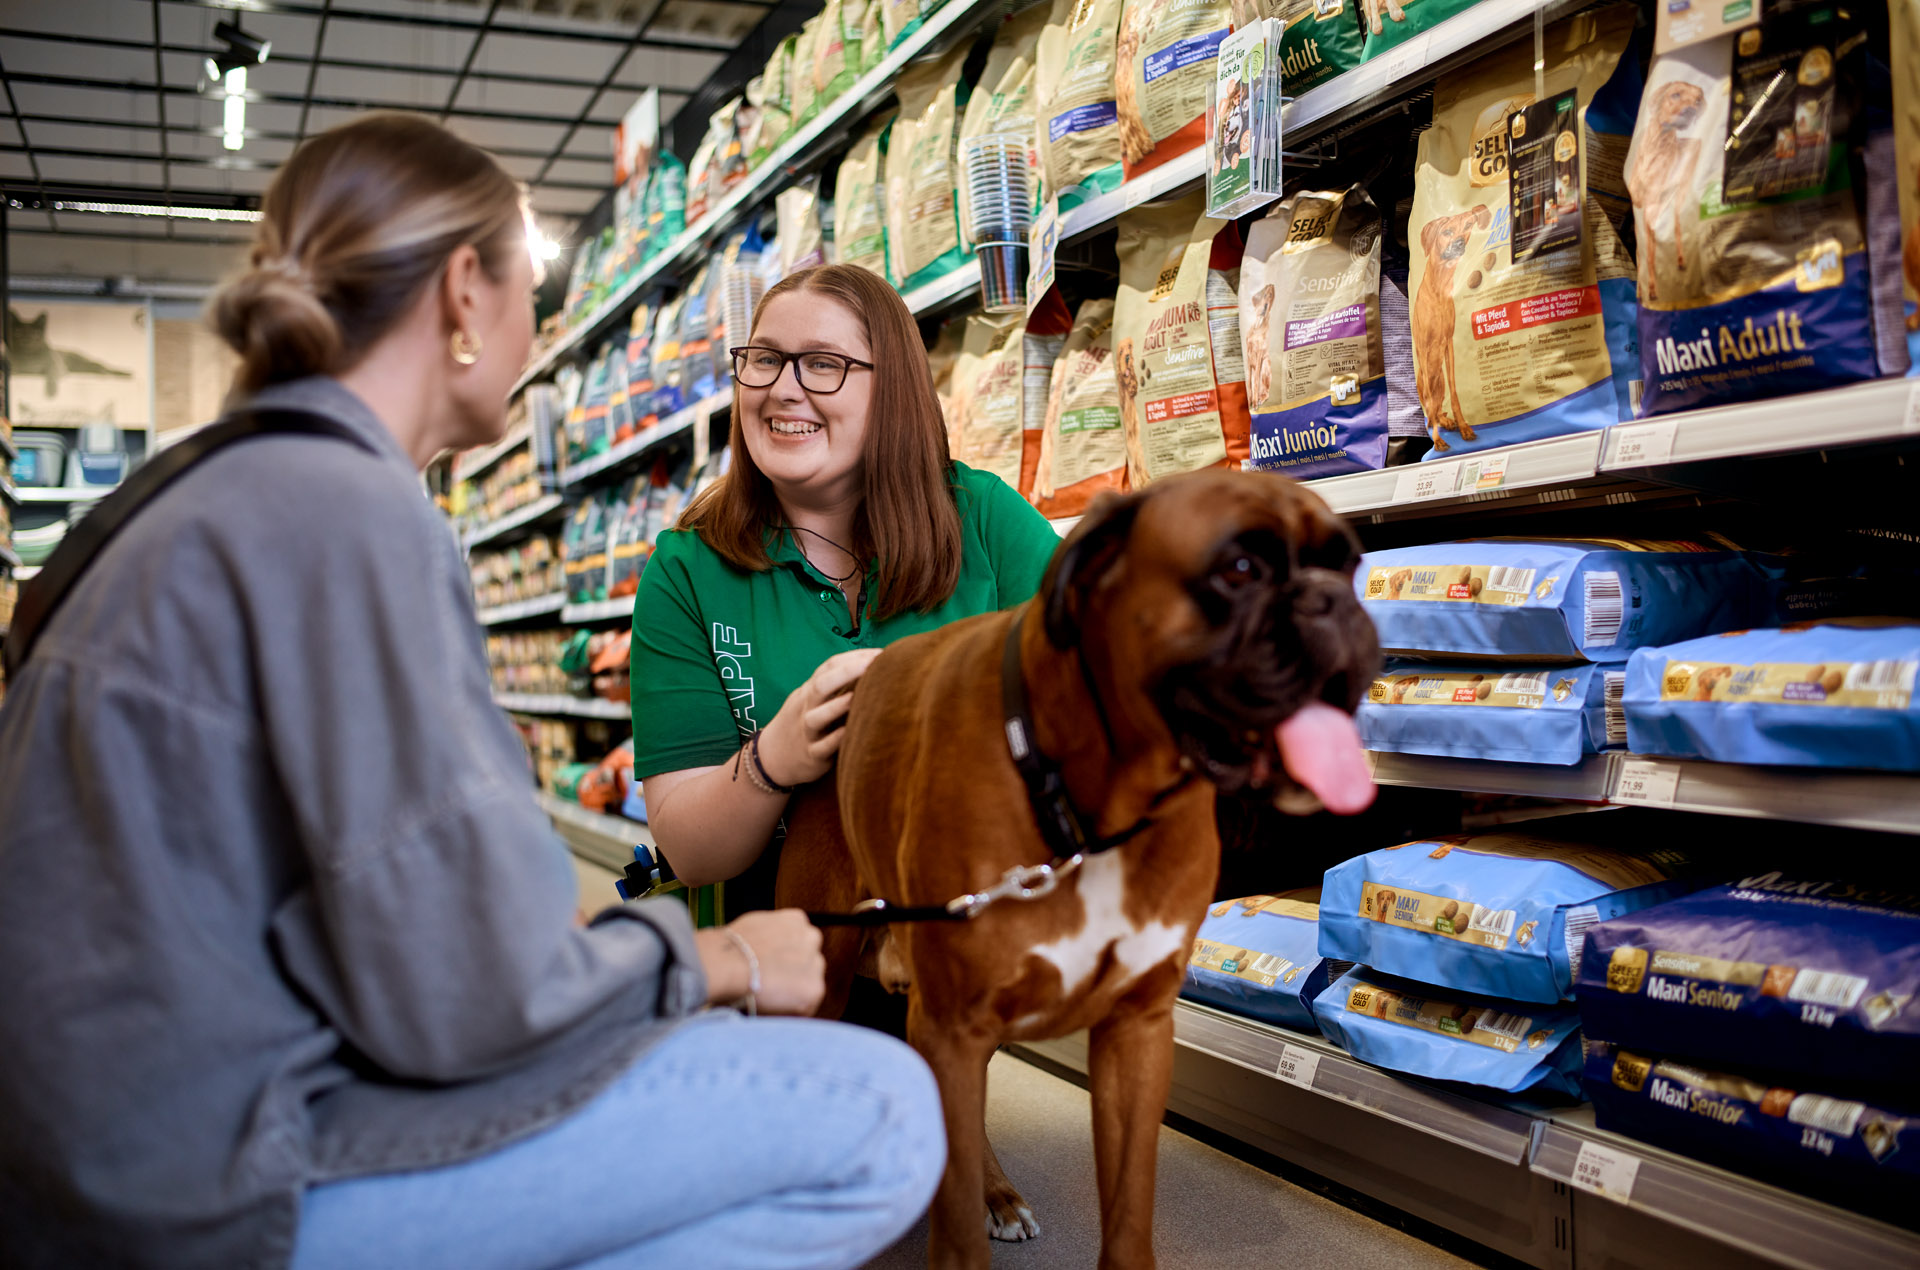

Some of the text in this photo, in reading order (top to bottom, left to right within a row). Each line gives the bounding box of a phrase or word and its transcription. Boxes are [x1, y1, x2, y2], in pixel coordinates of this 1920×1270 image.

[1219, 63, 1240, 81] dich da
[1474, 133, 1509, 159] SEL
[1479, 154, 1507, 177] GO
[1558, 290, 1581, 302] Tapioca
[1555, 299, 1578, 311] Tapioca
[1475, 307, 1507, 325] Mit Pferd
[1556, 307, 1579, 319] Tapioca
[1477, 318, 1511, 335] & Tapioka
[1655, 309, 1806, 375] Maxi Adult
[1164, 345, 1206, 365] Sensitive
[1332, 365, 1356, 373] FORMULA
[1250, 428, 1284, 460] Maxi
[1283, 421, 1338, 455] Junior
[1328, 450, 1347, 460] months
[1369, 580, 1385, 588] SELECT
[1412, 571, 1437, 585] MAXI
[1410, 585, 1428, 595] ADULT
[1504, 593, 1514, 603] 12
[713, 622, 757, 738] APF
[1418, 677, 1446, 690] MAXI
[1666, 677, 1690, 686] SELECT
[1372, 689, 1384, 697] GOLD
[1413, 689, 1433, 698] ADULT
[1517, 695, 1540, 709] 12 kg
[1396, 895, 1420, 911] MAXI
[1393, 910, 1414, 923] SENIOR
[1484, 934, 1505, 950] 12 kg
[1610, 963, 1642, 978] SELECT
[1653, 955, 1700, 972] Sensitive
[1353, 991, 1371, 1001] SELECT
[1647, 976, 1743, 1011] Maxi Senior
[1352, 999, 1367, 1008] GOLD
[1395, 1007, 1418, 1021] SENIOR
[1801, 1004, 1836, 1029] 12 kg
[1493, 1036, 1515, 1051] 12 kg
[1617, 1059, 1645, 1076] SELECT
[1616, 1071, 1641, 1086] GOLD
[1650, 1078, 1744, 1126] Maxi Senior
[1801, 1128, 1836, 1157] 12 kg
